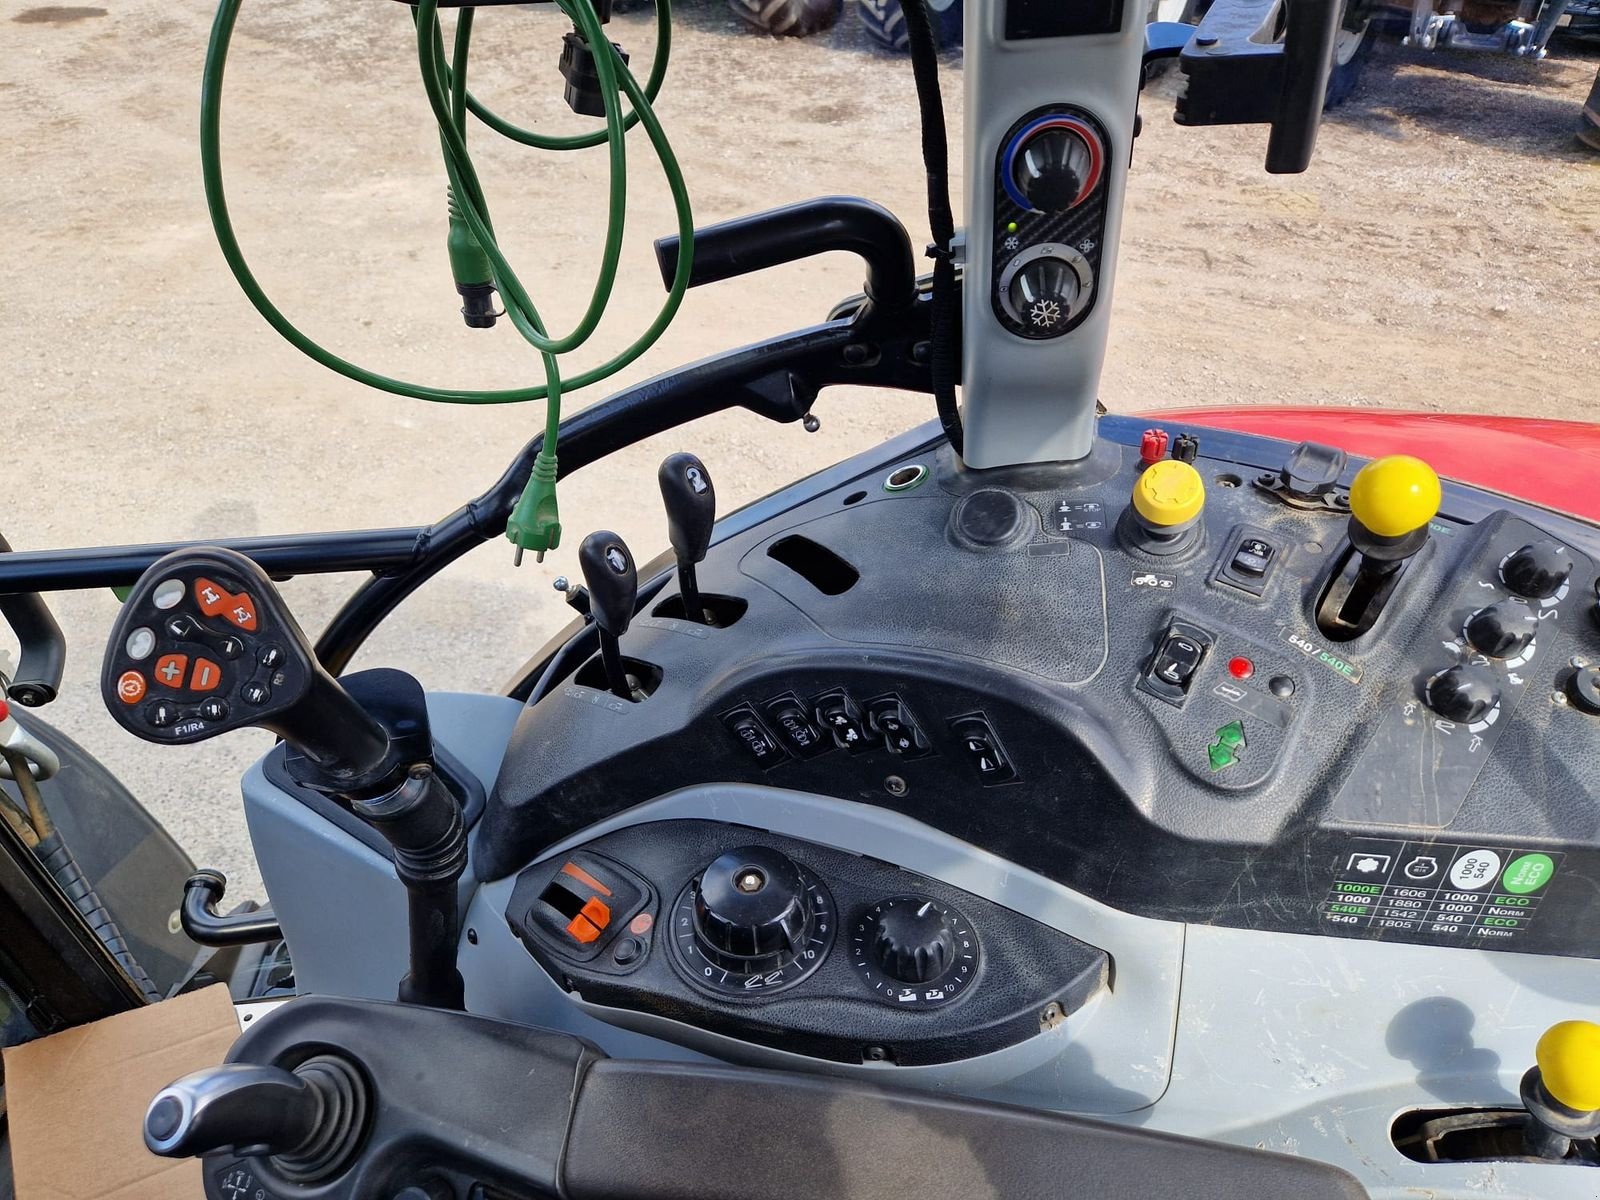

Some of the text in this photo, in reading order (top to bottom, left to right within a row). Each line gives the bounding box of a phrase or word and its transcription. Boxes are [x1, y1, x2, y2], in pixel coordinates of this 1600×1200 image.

[686, 466, 707, 493] 2
[174, 721, 206, 736] F1/R4
[1459, 857, 1479, 881] 1000
[1473, 861, 1491, 880] 540
[1524, 862, 1545, 886] ECO
[1335, 882, 1531, 907] 1000E 1606 1000 ECO
[816, 896, 824, 904] 8
[1336, 894, 1372, 905] 1000
[1387, 899, 1422, 909] 1880
[1438, 903, 1474, 913] 1000
[1330, 904, 1519, 928] 540E 1542 540 ECO
[681, 918, 689, 926] 2
[1331, 914, 1359, 925] 540
[1378, 919, 1412, 929] 1805
[1431, 923, 1459, 933] 540
[820, 924, 827, 933] 9
[963, 940, 970, 948] 8
[803, 950, 816, 960] 10
[855, 948, 861, 956] 2
[704, 967, 712, 976] 0
[961, 965, 968, 973] 9
[886, 989, 893, 997] 0
[944, 984, 956, 993] 10
